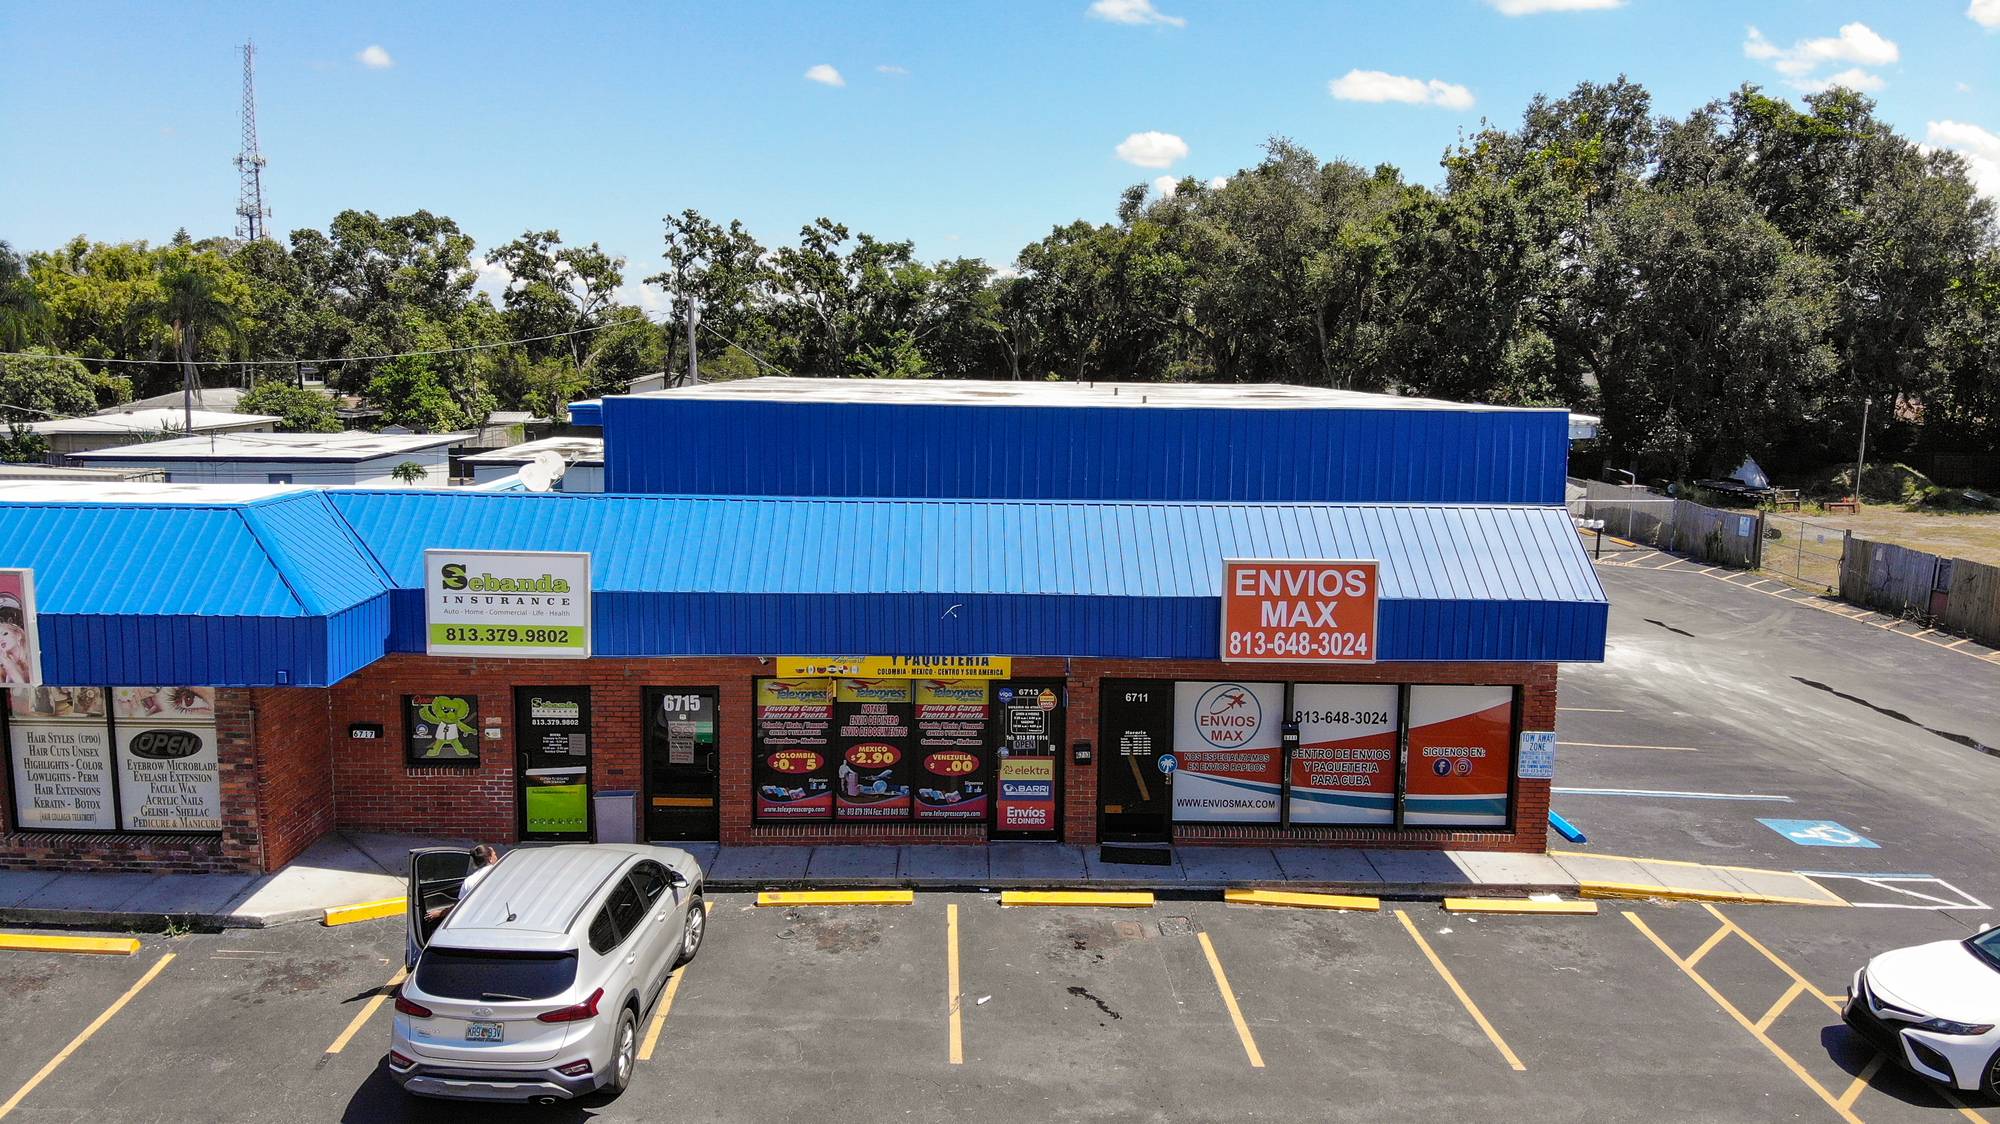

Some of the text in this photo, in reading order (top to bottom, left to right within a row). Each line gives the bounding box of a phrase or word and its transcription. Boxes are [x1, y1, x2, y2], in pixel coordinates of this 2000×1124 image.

[441, 563, 570, 593] Sebanda
[1235, 569, 1367, 597] ENVIOS
[443, 595, 570, 606] INSURANCE
[1260, 600, 1338, 628] MAX
[446, 628, 569, 643] 813.379.9802
[1229, 631, 1367, 656] 813-648-3024
[904, 656, 990, 667] PAQUETERIA
[663, 694, 700, 711] 6715
[1125, 692, 1148, 702] 6711
[1200, 715, 1256, 727] ENVIOS
[1295, 710, 1388, 725] 813-648-3024
[26, 731, 46, 744] HAIR
[48, 732, 75, 744] STYLES
[353, 730, 374, 738] 6717
[1211, 730, 1244, 741] MAX
[1522, 734, 1553, 743] TOW AWAY
[138, 733, 196, 755] OPEN
[1015, 740, 1035, 748] OPEN
[1529, 743, 1546, 751] ZONE
[29, 745, 99, 757] HAIR CUTS UNISEX
[1183, 752, 1270, 762] NOS ESPECIALIZAMOS
[1335, 749, 1351, 759] DE
[1351, 749, 1391, 760] ENVIOS
[1422, 746, 1486, 758] SIGUENOS EN:
[23, 757, 103, 770] HIGHLIGHTS COLOR
[850, 752, 894, 764] $2.90
[127, 759, 217, 771] EYEBROW MICROBLADE
[1015, 766, 1050, 775] elektra
[1187, 762, 1266, 773] EN ENVIOS RAPIDOS
[1303, 761, 1379, 773] Y PAQUETERIA
[27, 770, 99, 782] LOWLIGHTS PERM
[133, 771, 212, 782] EYELASH EXTENSION
[1311, 774, 1371, 786] PARA CUBA
[34, 783, 101, 796] HAIR EXTENSIONS
[150, 782, 197, 794] FACIAL WAX
[1018, 785, 1050, 793] BARRI
[34, 796, 101, 809] KERATIN BOTOX
[146, 794, 204, 806] ACRYLIC NAILS
[1176, 798, 1275, 808] WWW.ENVIOSMAX.COM
[140, 805, 209, 817] GELISH SHELLAC
[1006, 806, 1046, 817] Envíos
[133, 816, 171, 828] PEDICURE
[179, 817, 221, 829] MANICURE
